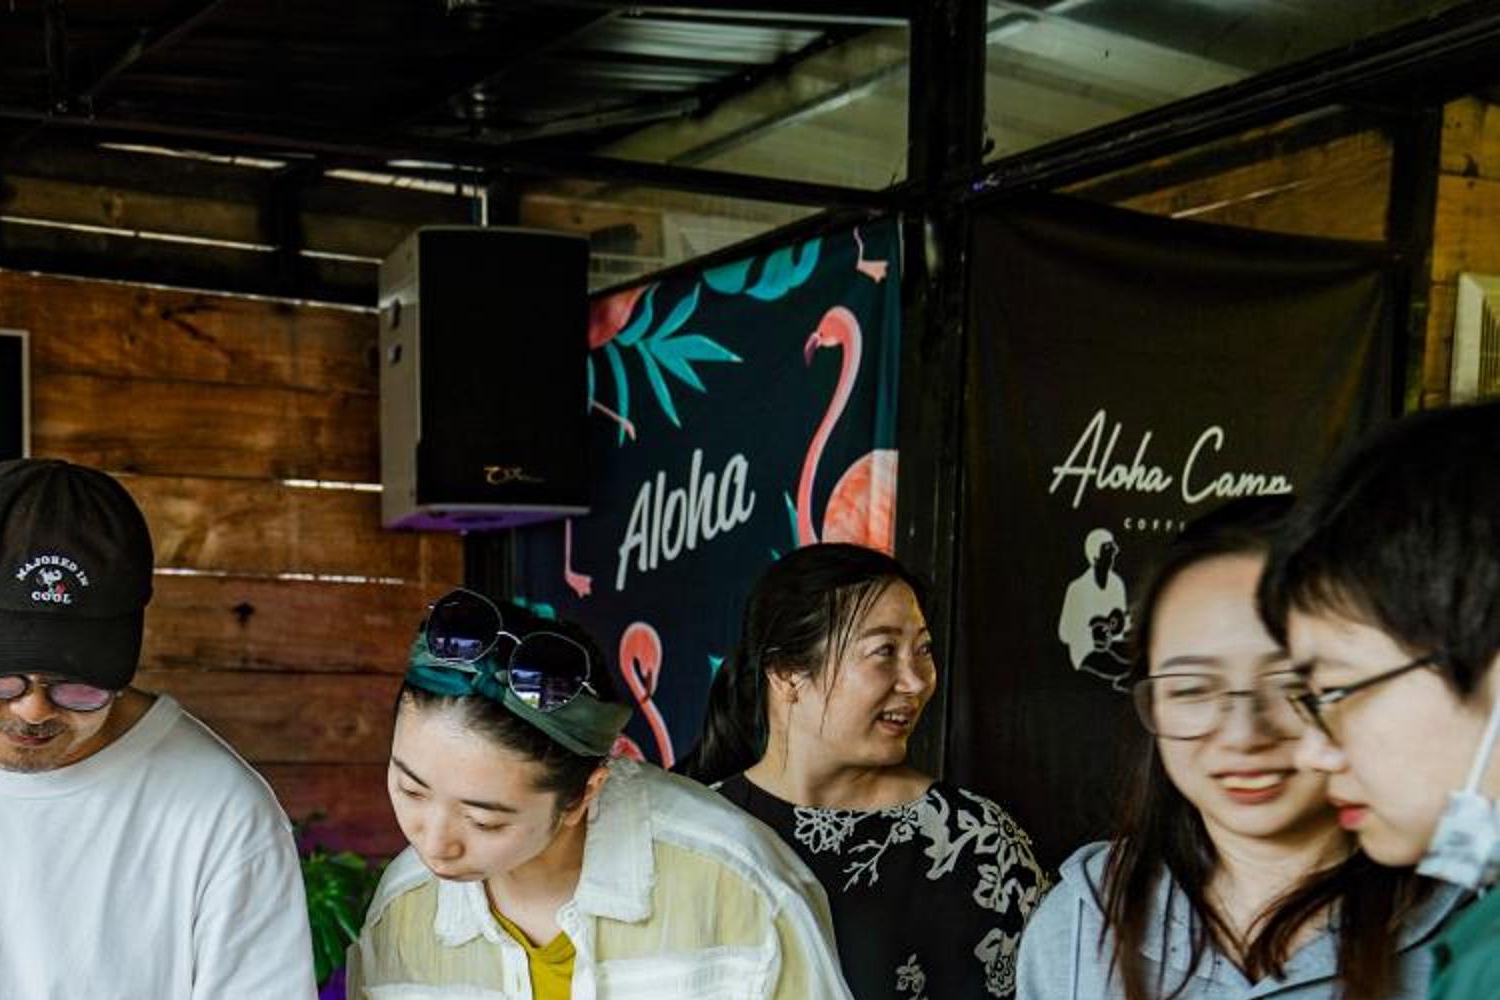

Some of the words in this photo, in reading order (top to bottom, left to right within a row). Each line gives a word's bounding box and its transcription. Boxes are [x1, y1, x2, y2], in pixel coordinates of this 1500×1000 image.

[1049, 409, 1172, 509] Aloha
[616, 448, 756, 591] Aloha
[16, 556, 77, 580] MAJORED
[31, 591, 71, 604] COOL
